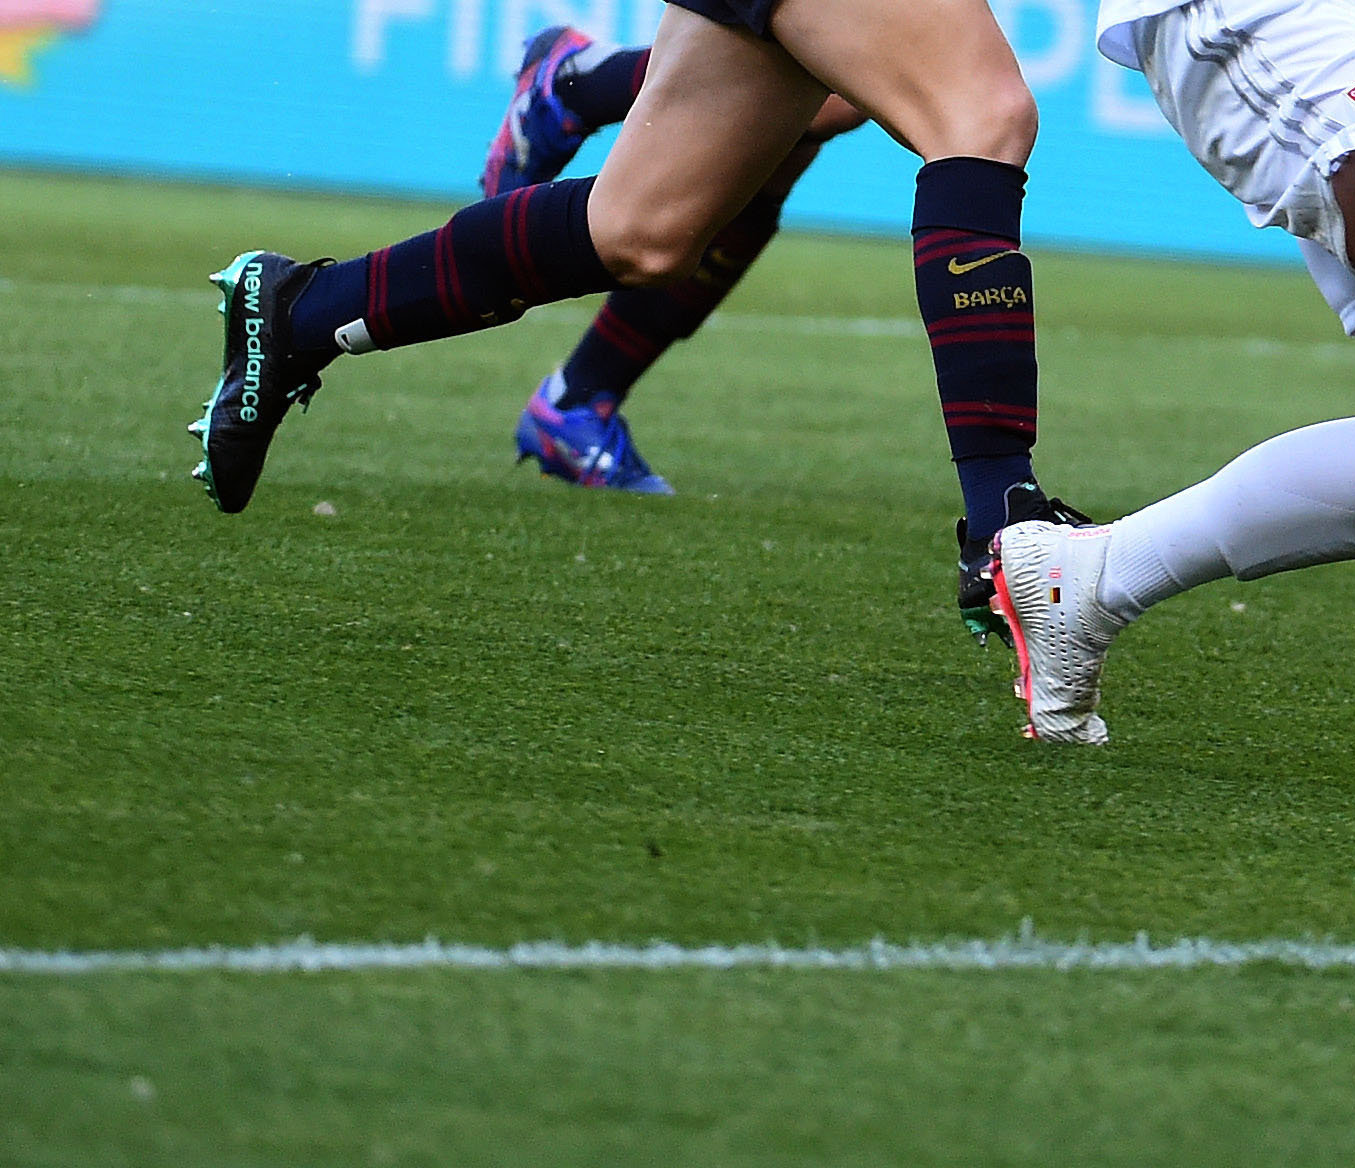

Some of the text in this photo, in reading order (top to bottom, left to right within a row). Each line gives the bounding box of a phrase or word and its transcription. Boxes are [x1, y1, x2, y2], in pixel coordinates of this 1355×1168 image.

[239, 262, 265, 422] new balance
[953, 286, 1027, 309] BARÇA
